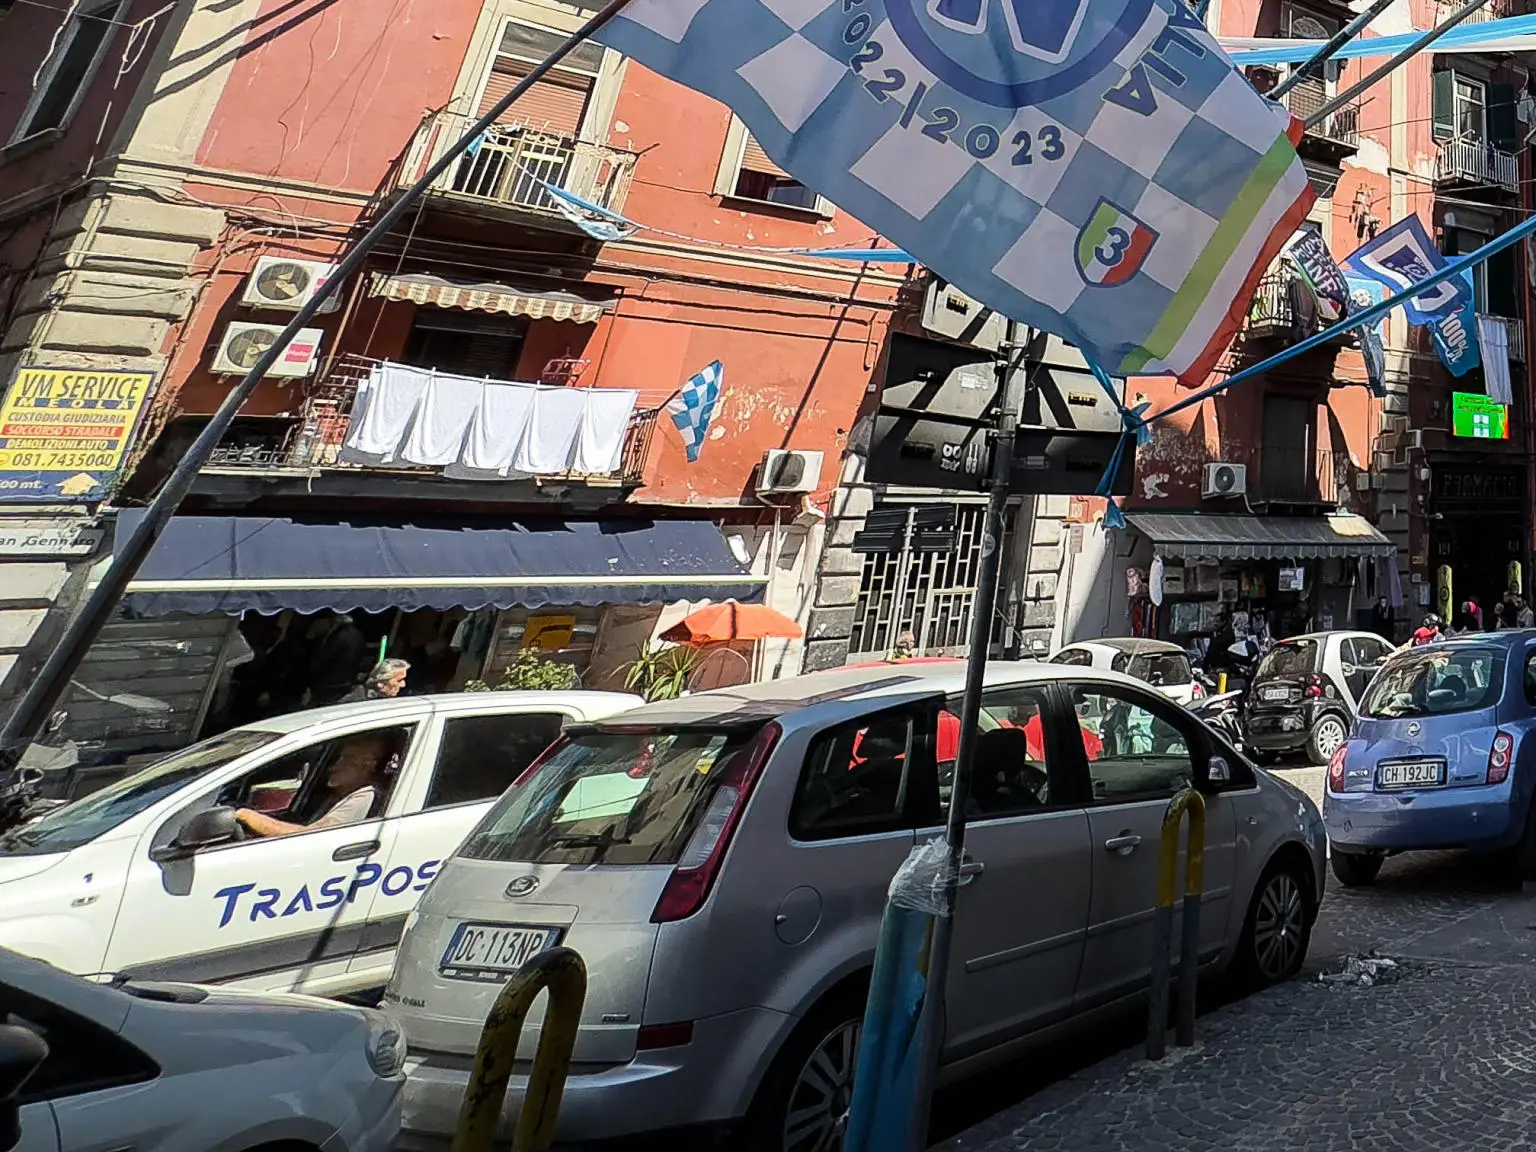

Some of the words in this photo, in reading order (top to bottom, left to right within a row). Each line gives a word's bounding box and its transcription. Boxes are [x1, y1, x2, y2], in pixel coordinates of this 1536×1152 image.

[1092, 225, 1132, 269] 3
[22, 373, 56, 397] VM
[57, 374, 142, 399] SERVICE
[8, 412, 61, 423] CUSTODIA
[63, 413, 126, 424] GIUDIZIARIA
[7, 425, 63, 436] SOCCORSO
[64, 426, 119, 437] STRADALE
[6, 438, 78, 449] DEMOLIZIONI
[80, 440, 109, 450] AUTO
[21, 535, 96, 547] Gennaro
[1403, 765, 1437, 782] 192JC
[482, 931, 545, 966] 113NP
